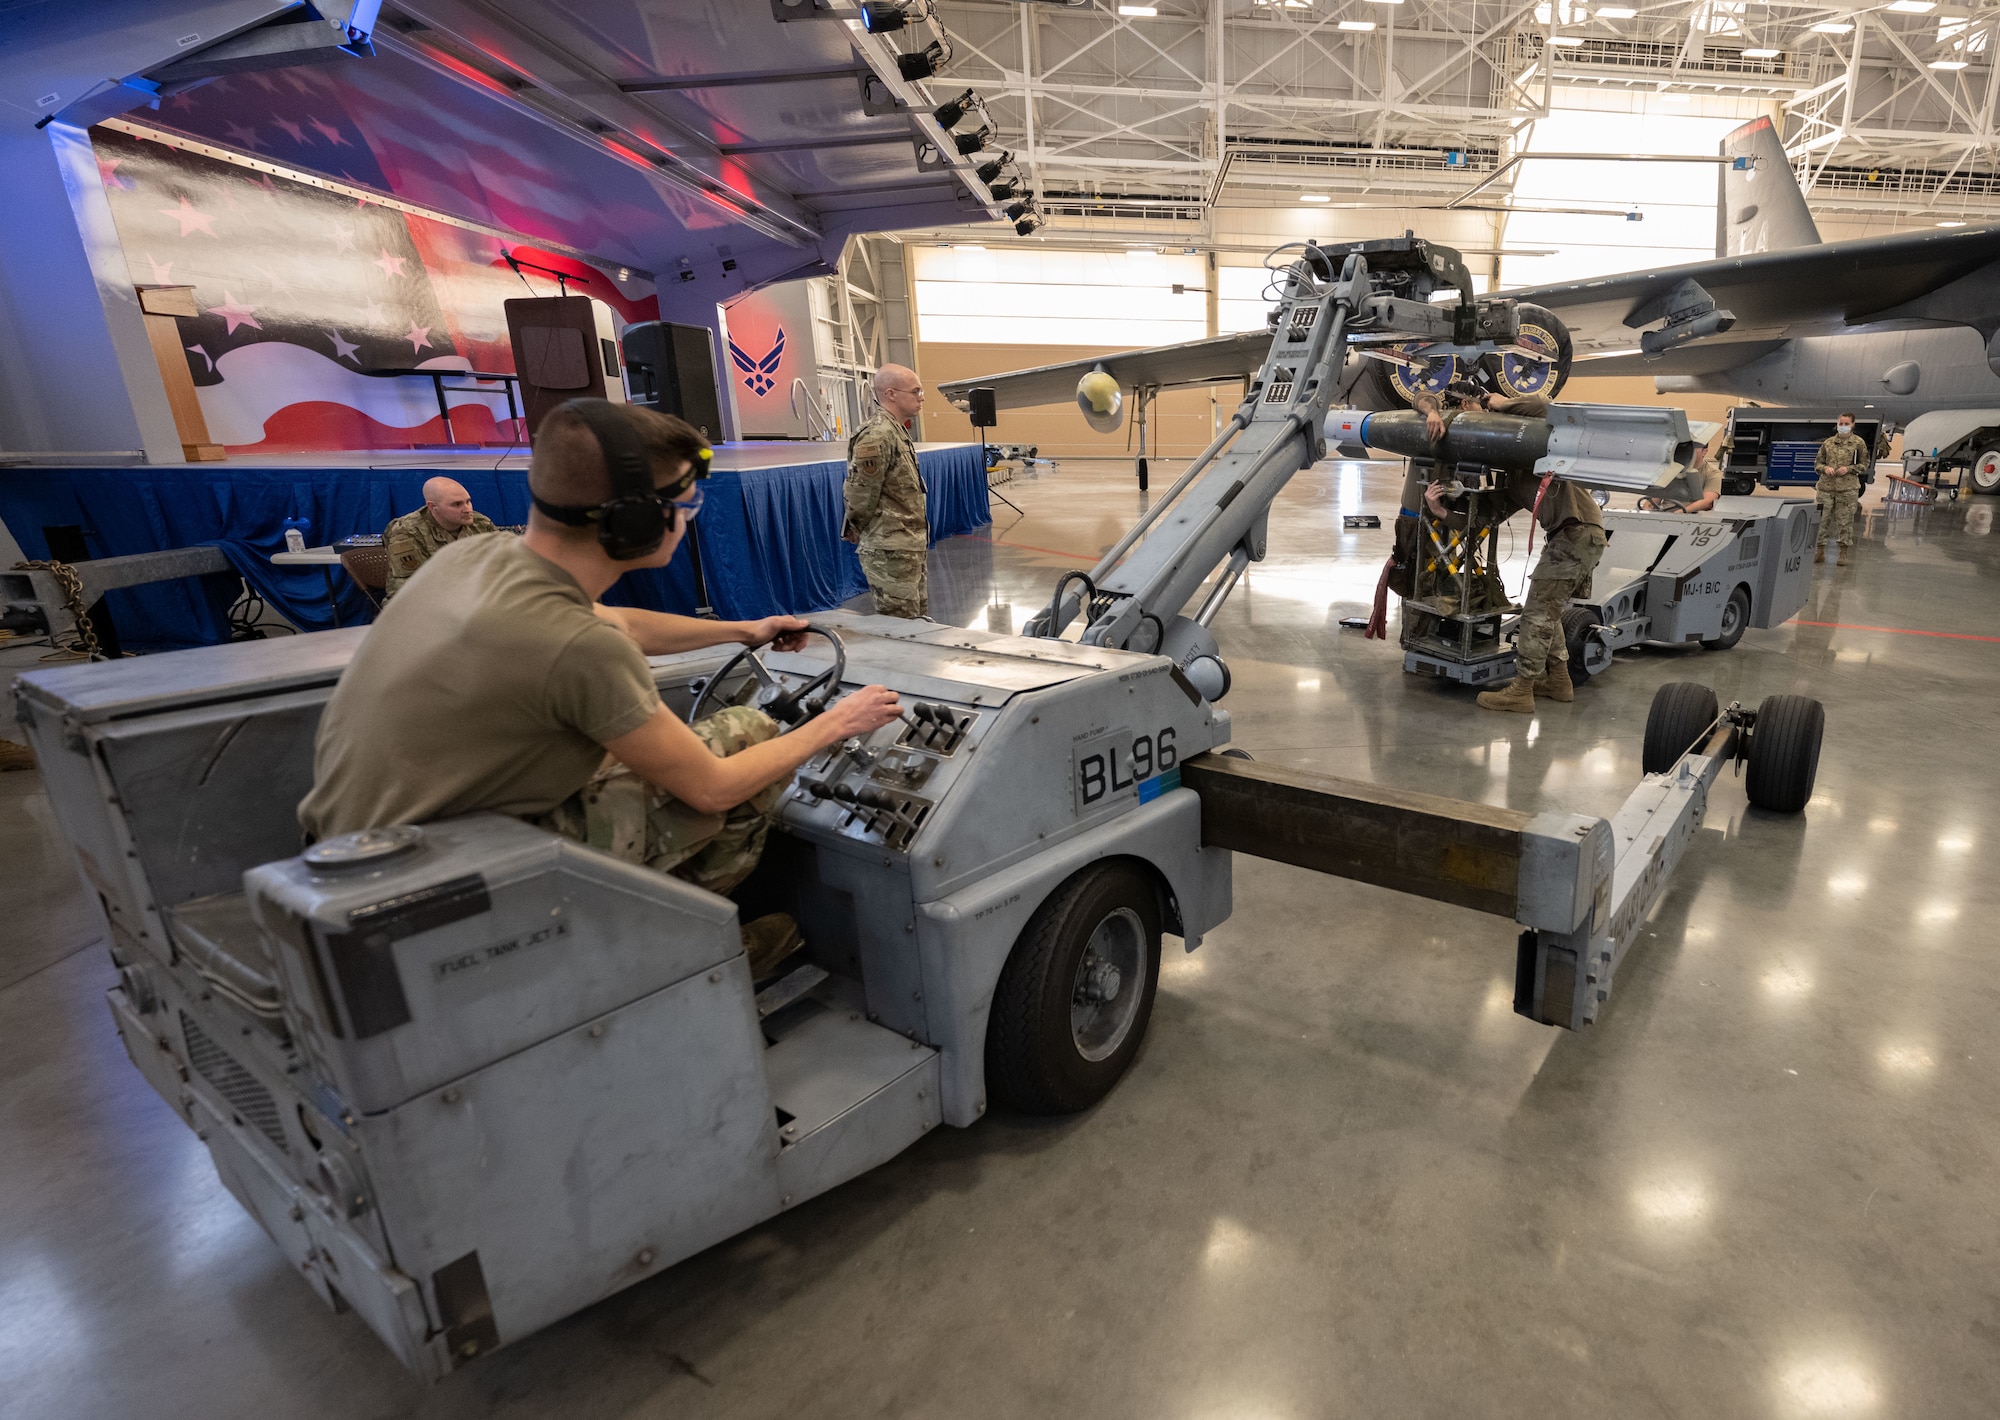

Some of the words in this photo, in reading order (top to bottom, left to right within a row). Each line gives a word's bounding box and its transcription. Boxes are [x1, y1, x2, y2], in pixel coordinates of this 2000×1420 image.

[1691, 526, 1723, 537] MJ
[1690, 536, 1710, 547] 19
[1683, 583, 1703, 596] MJ-1
[1705, 581, 1721, 594] B/C
[1179, 642, 1200, 672] PACITY
[1072, 731, 1089, 743] HAND
[1089, 726, 1105, 737] PUMP
[1080, 726, 1177, 806] BL96
[439, 954, 479, 975] FUEL
[485, 940, 519, 959] TANK
